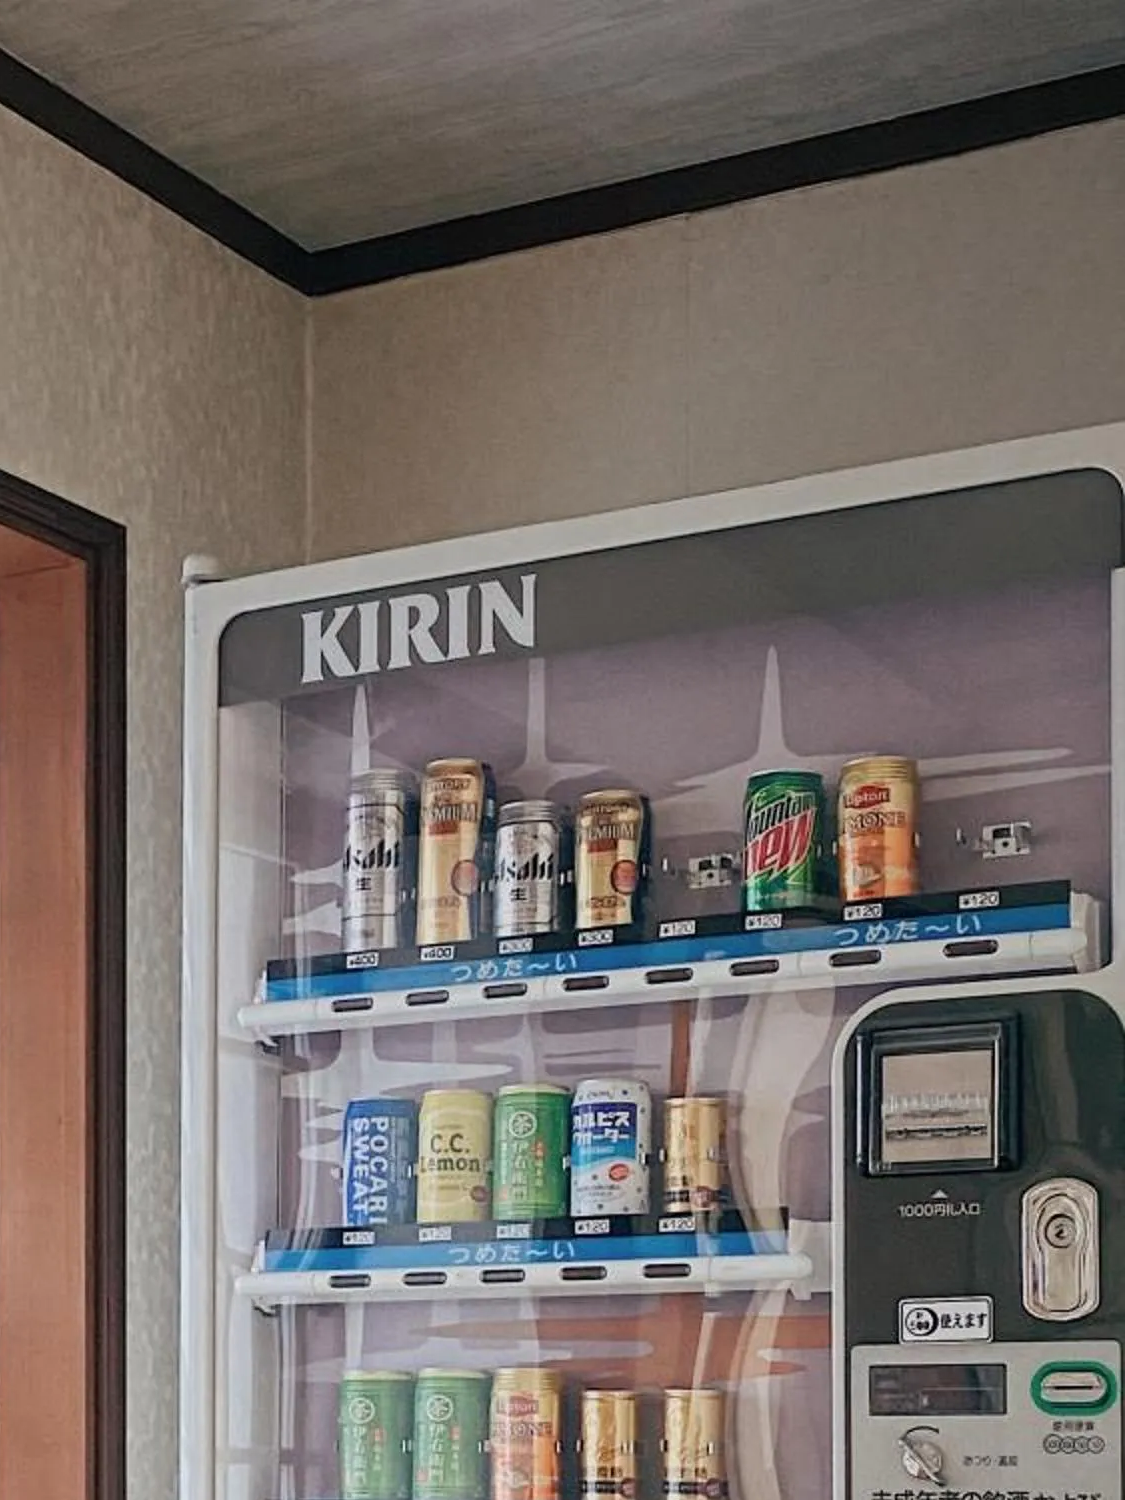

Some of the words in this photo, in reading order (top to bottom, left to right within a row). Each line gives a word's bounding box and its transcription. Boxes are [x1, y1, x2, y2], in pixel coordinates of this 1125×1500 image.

[301, 573, 537, 683] KIRIN
[352, 1118, 371, 1215] SWEAT
[370, 1116, 389, 1224] POCARI
